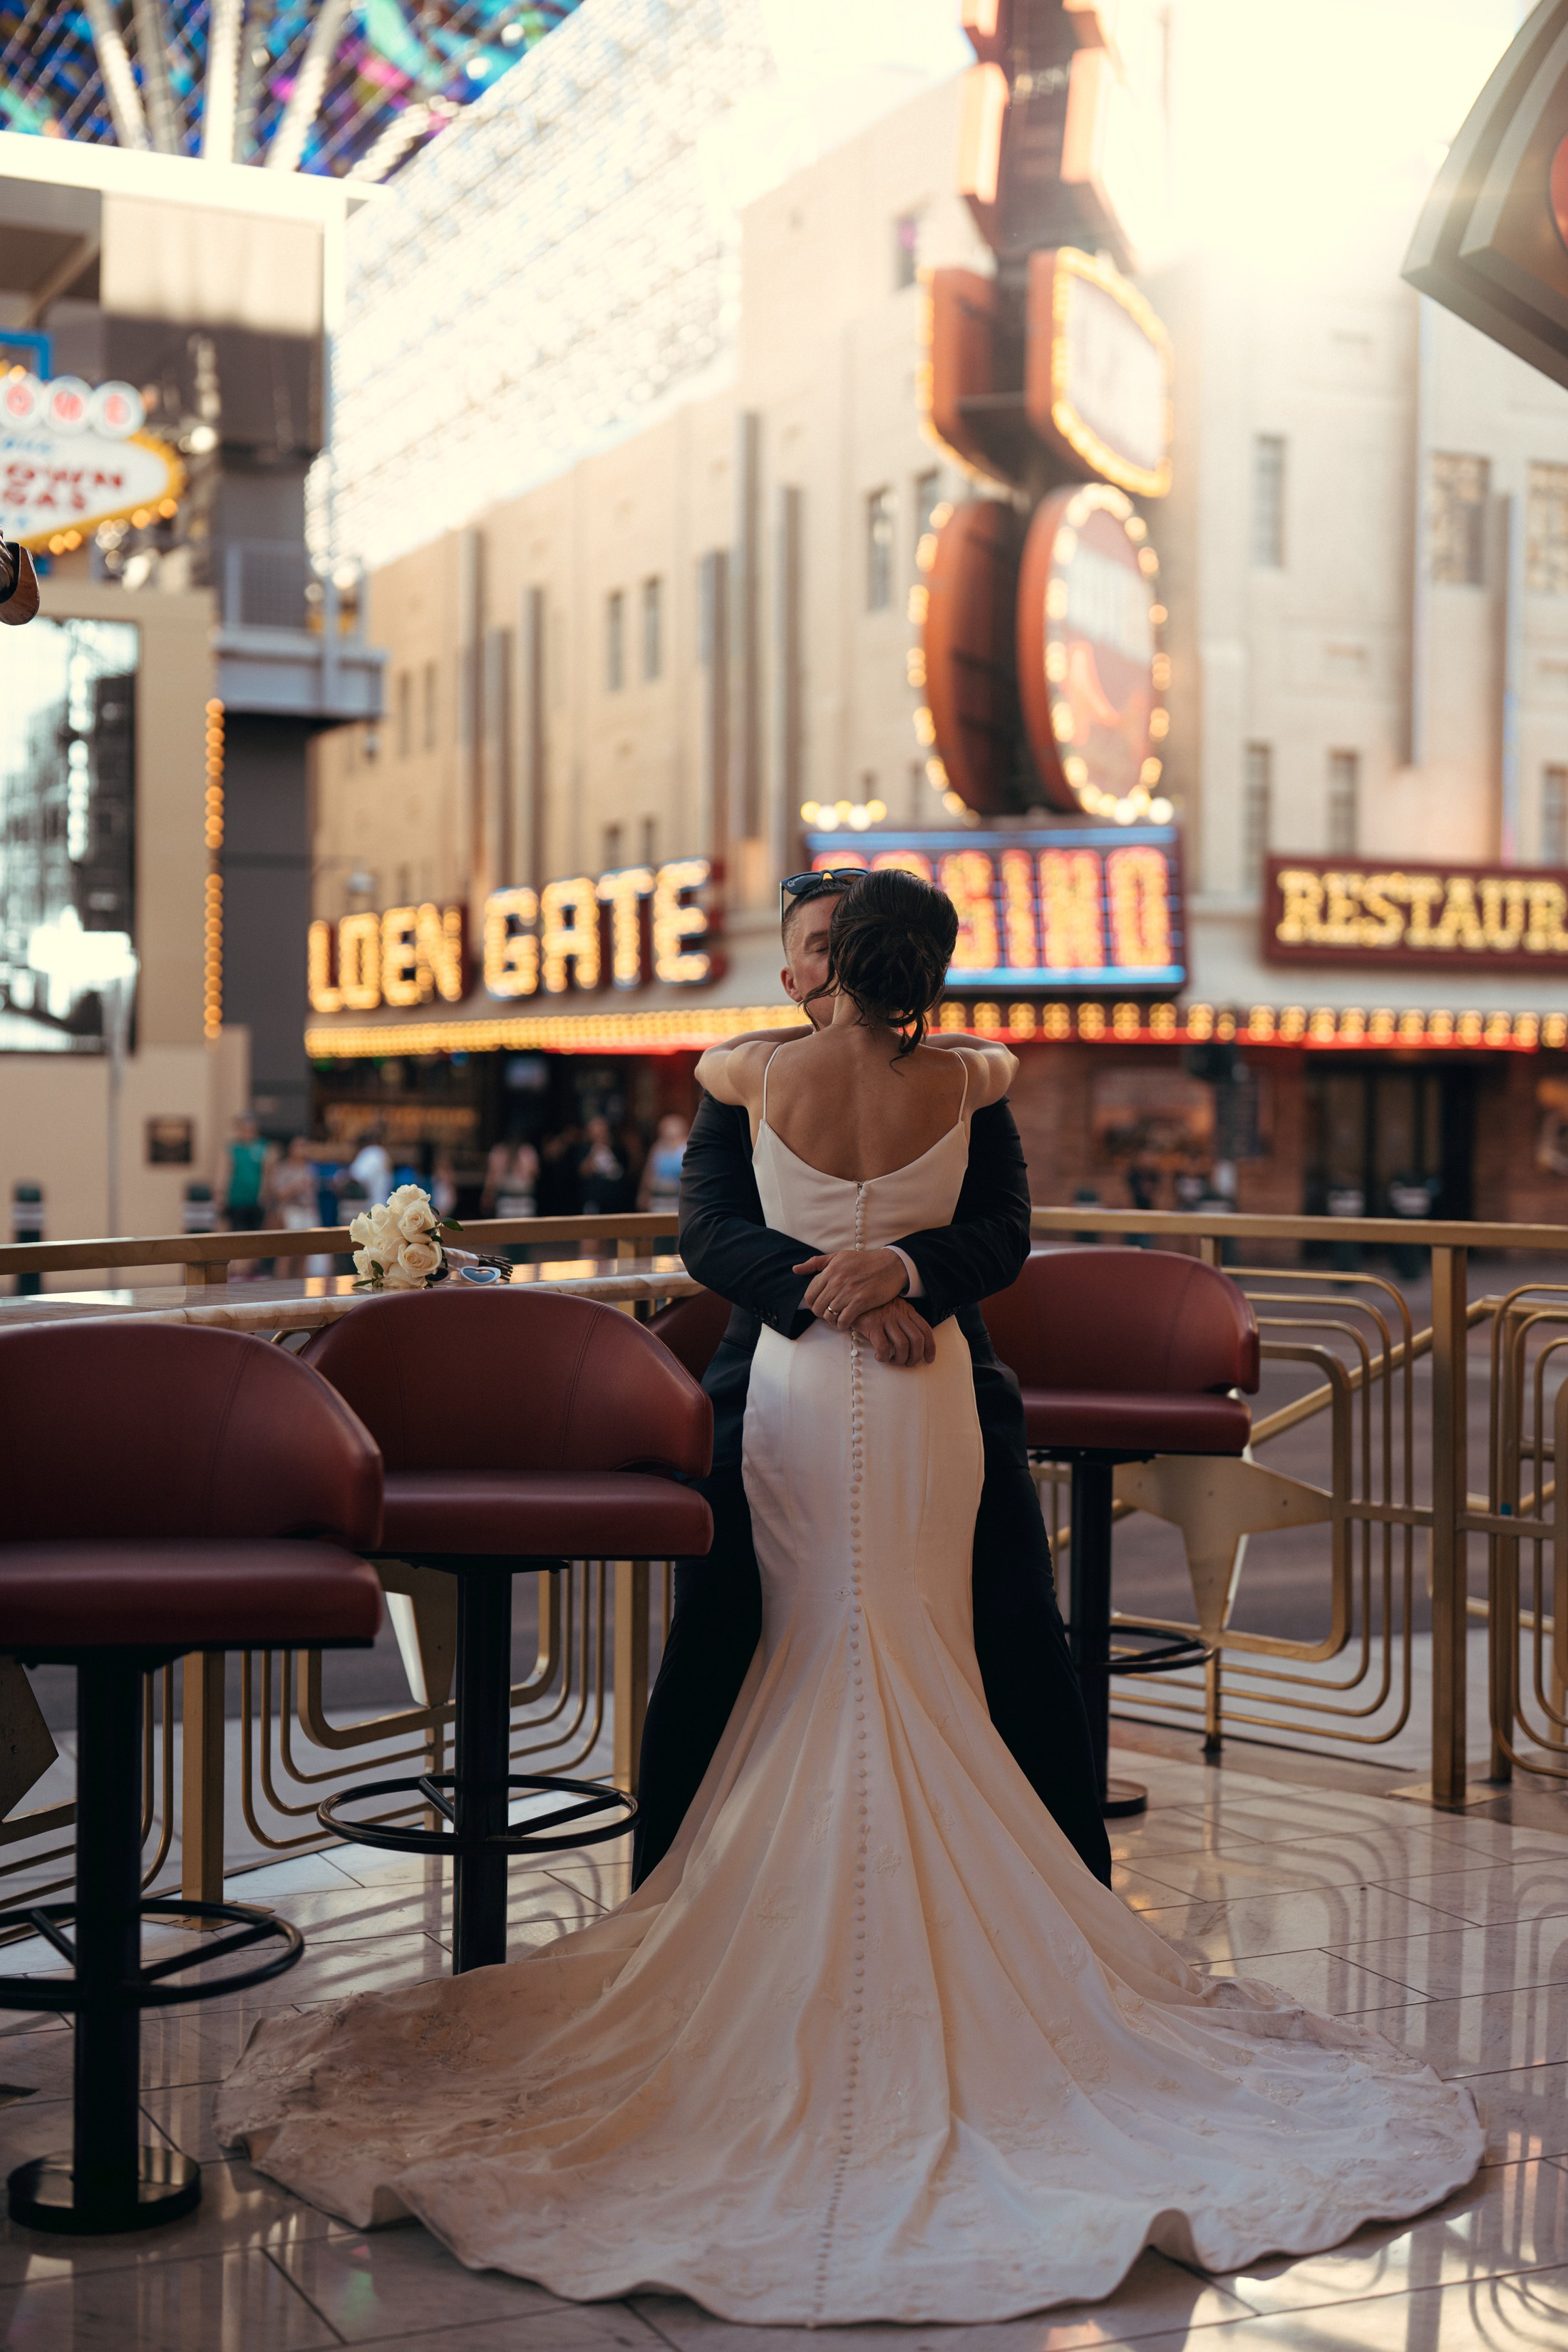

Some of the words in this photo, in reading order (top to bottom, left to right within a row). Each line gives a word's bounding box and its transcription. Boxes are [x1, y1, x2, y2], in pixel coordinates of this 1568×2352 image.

[484, 857, 710, 1000] GATE
[811, 846, 1175, 969] SINO
[1276, 871, 1568, 951] RESTAUR
